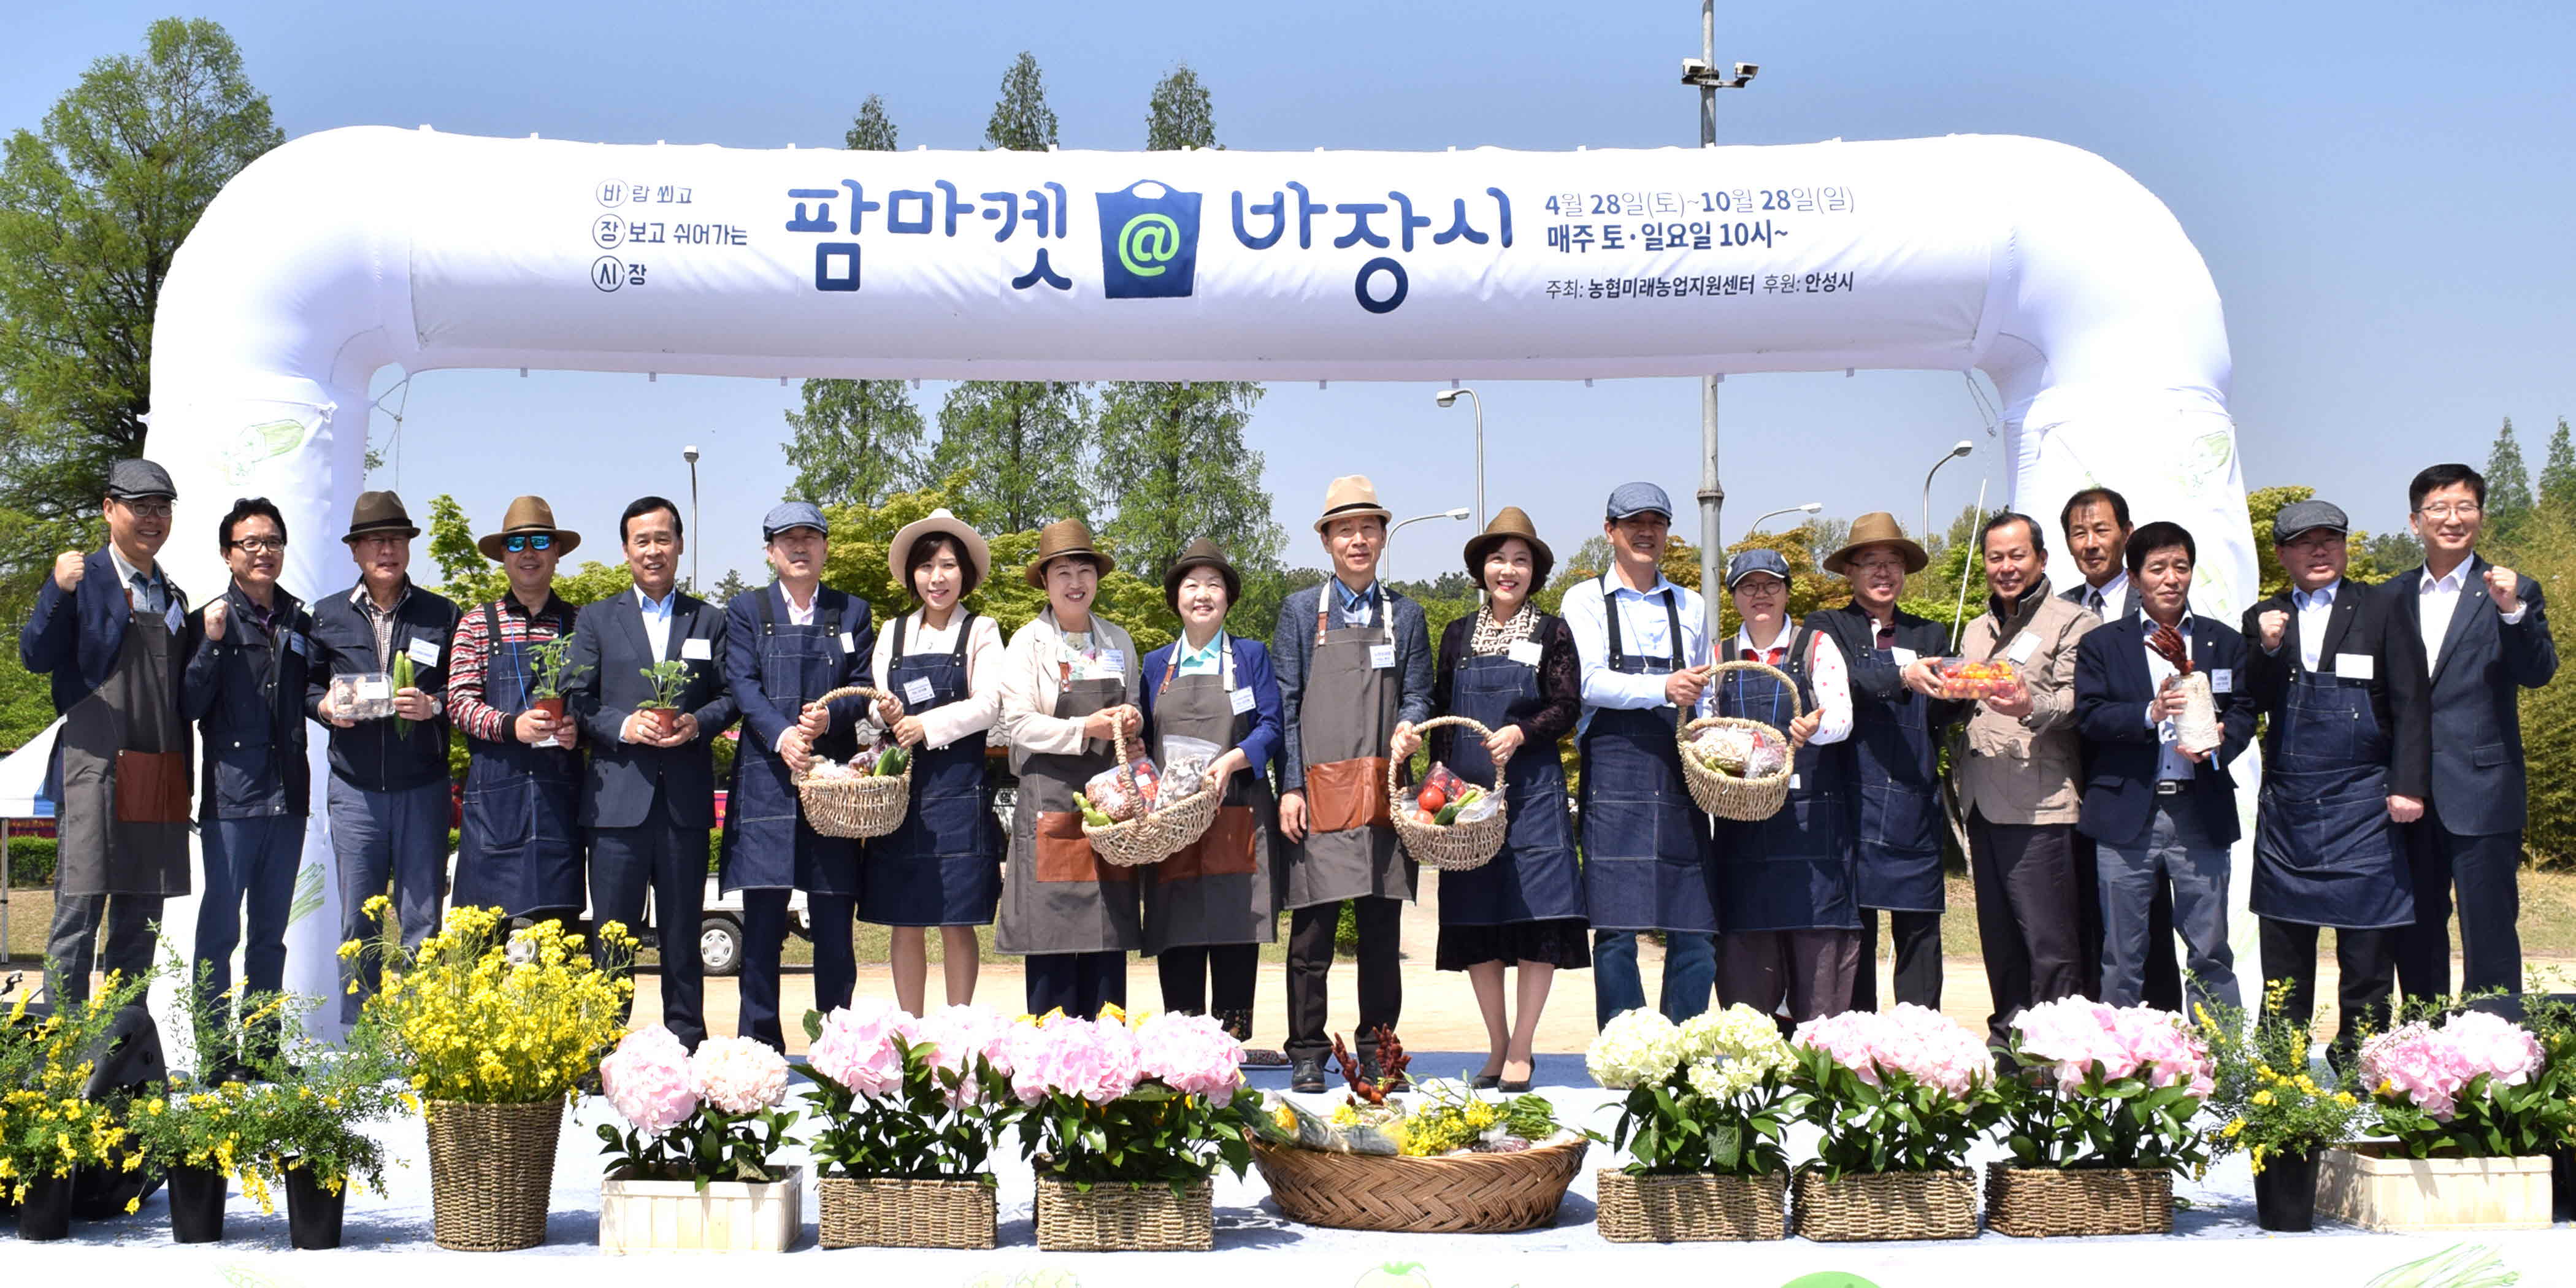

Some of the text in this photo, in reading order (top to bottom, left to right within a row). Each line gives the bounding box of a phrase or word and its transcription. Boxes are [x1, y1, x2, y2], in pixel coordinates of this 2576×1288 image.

[656, 185, 692, 204] 쐬고
[1545, 193, 1583, 217] 4월
[1760, 186, 1854, 215] 28일(일)
[673, 223, 748, 246] 쉬어가는
[785, 178, 1513, 315] 팜마켓 @ 바장시
[1547, 223, 1595, 253] 매주
[1720, 218, 1788, 248] 10시~
[1546, 270, 1854, 300] 주최: 농협미래농업지원센터 후원: 안성시
